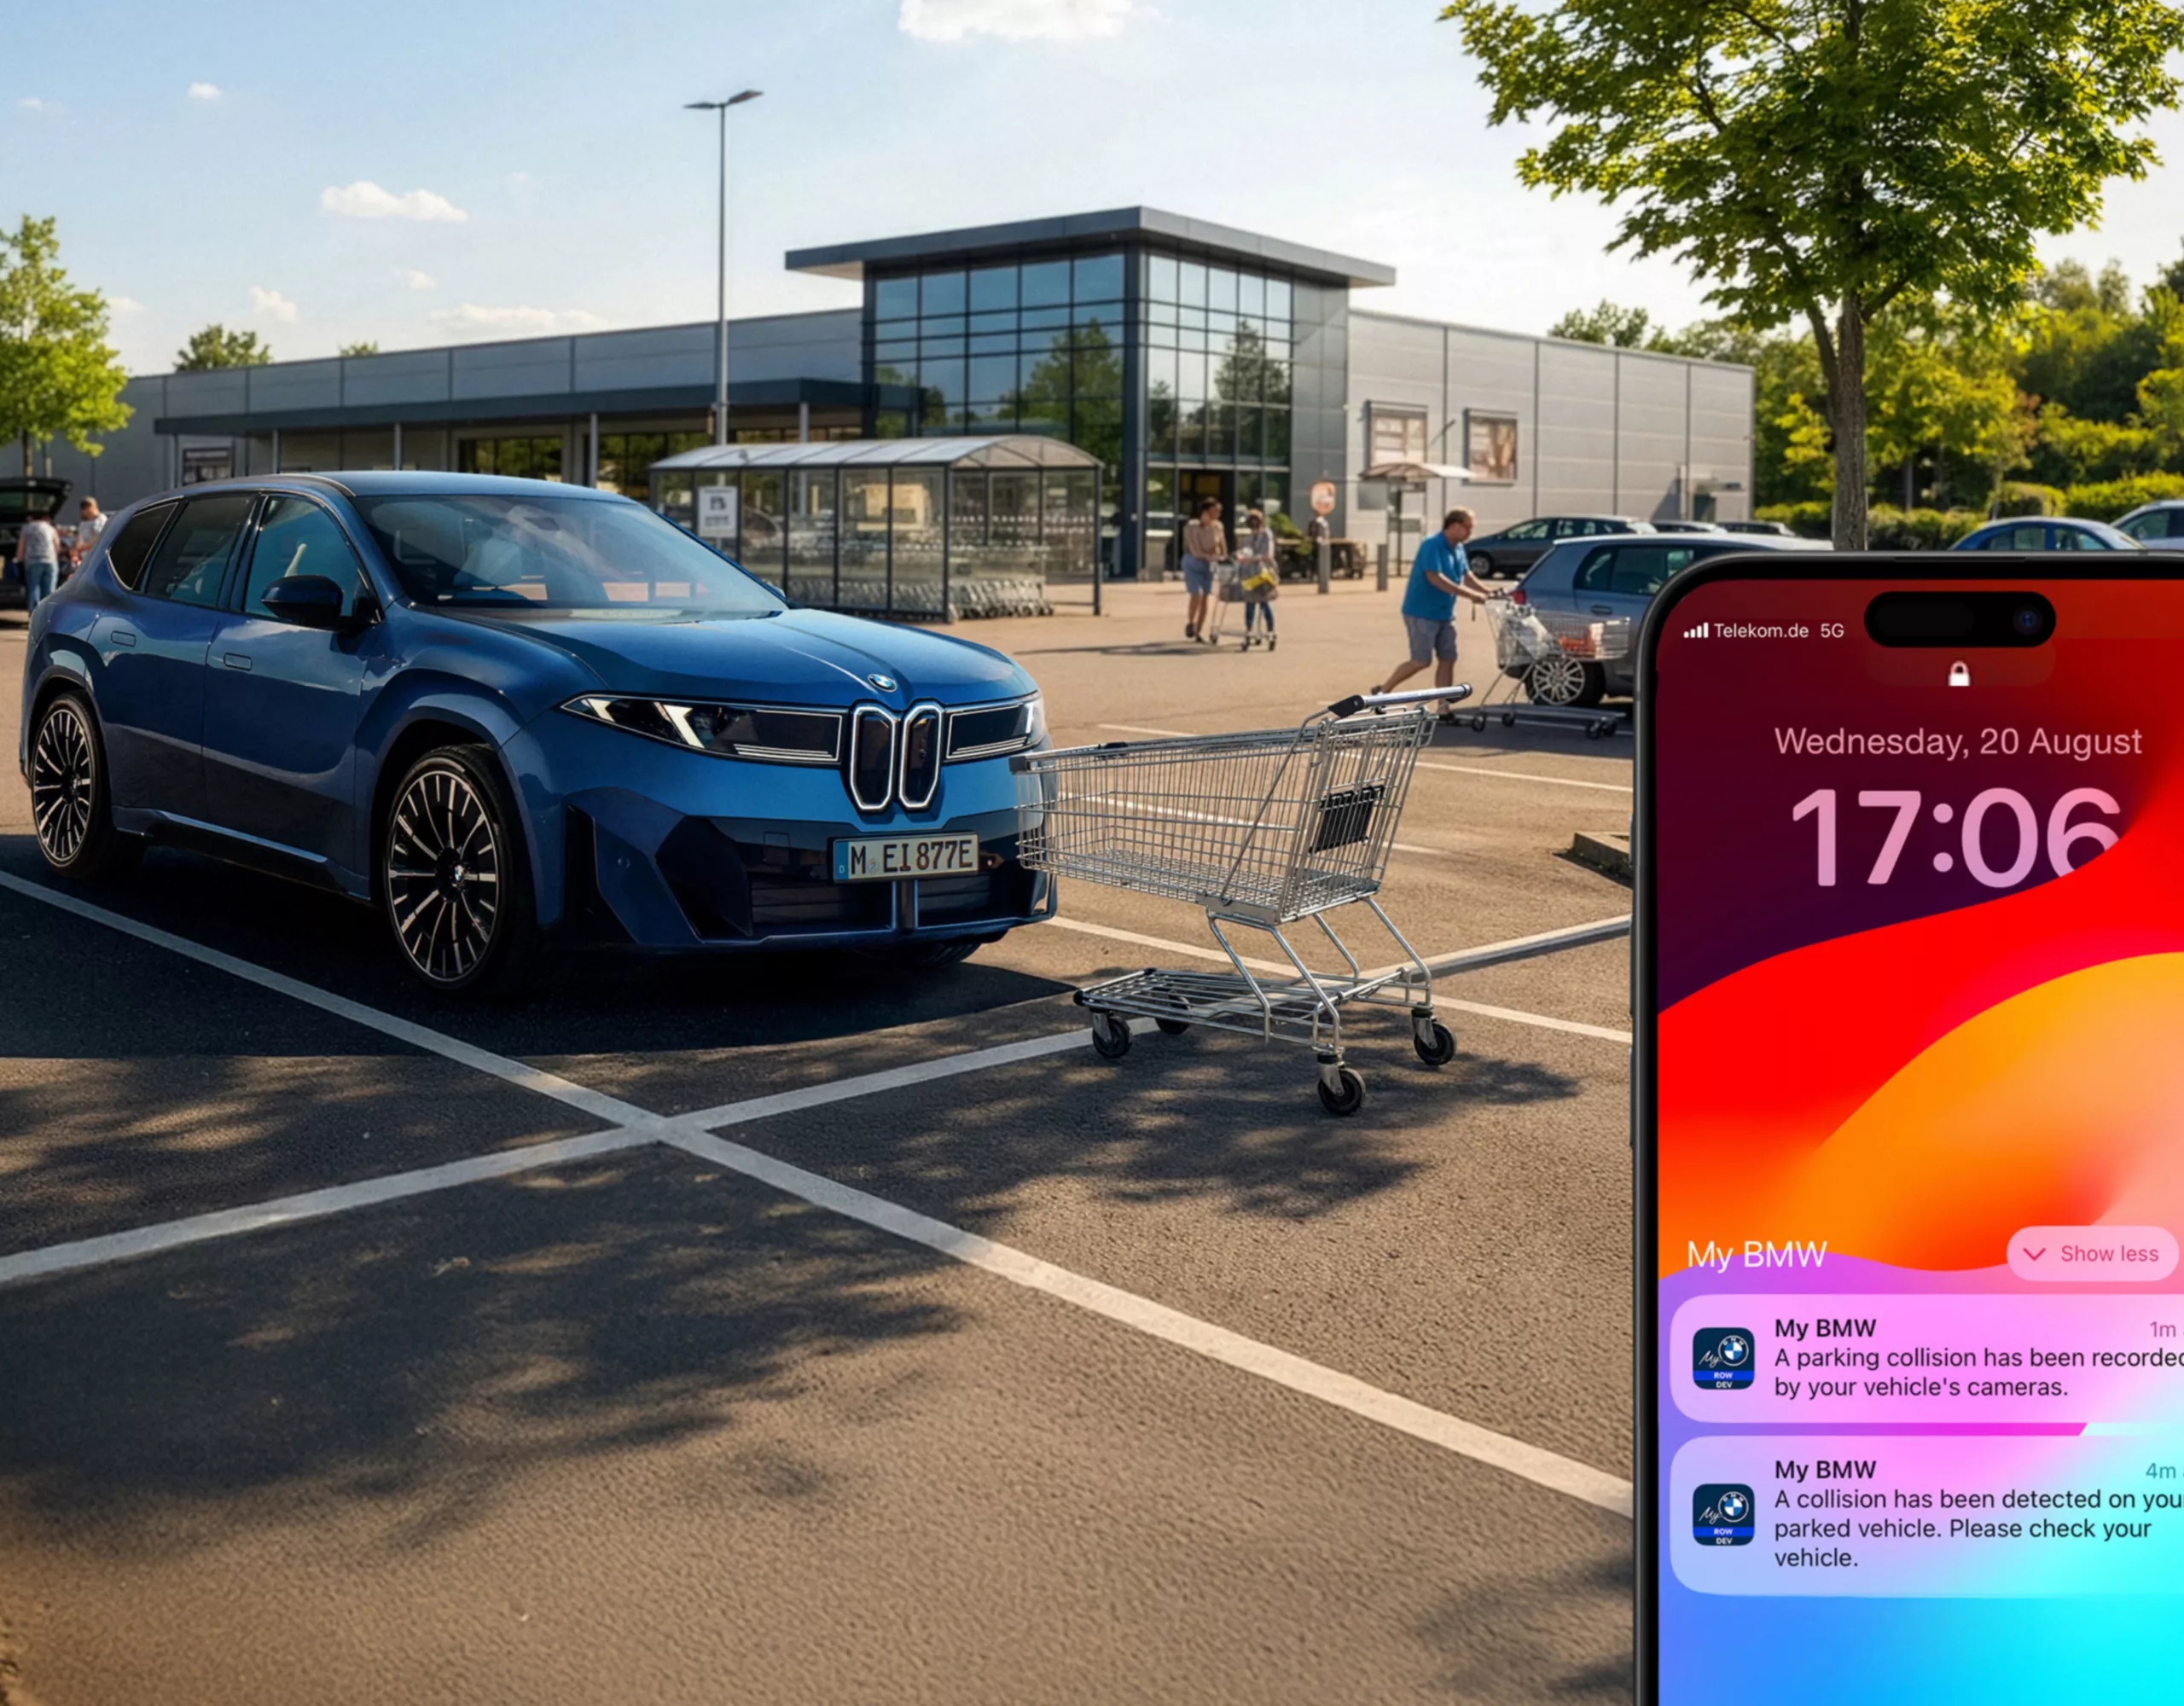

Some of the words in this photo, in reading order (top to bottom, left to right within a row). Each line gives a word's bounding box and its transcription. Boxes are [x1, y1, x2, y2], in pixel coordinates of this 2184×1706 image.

[1713, 623, 1809, 639] Telekom.de
[1821, 623, 1844, 639] 5G
[1774, 727, 1969, 762] Wednesday,
[1980, 727, 2019, 755] 20
[2029, 727, 2143, 762] August
[1792, 786, 2122, 889] 17:06
[851, 845, 866, 874] M
[1687, 1240, 1734, 1274] My
[1743, 1240, 1827, 1268] BMW
[2061, 1245, 2115, 1262] Show
[2122, 1245, 2159, 1262] less
[1774, 1318, 1809, 1343] My
[1815, 1318, 1877, 1338] BMW
[2150, 1320, 2176, 1338] 1m
[1774, 1348, 1791, 1367] A
[1797, 1347, 1879, 1372] parking
[1886, 1347, 1977, 1367] collision
[1984, 1347, 2023, 1367] has
[2030, 1347, 2085, 1367] been
[1774, 1376, 1801, 1401] by
[1808, 1381, 1857, 1401] your
[1863, 1376, 1961, 1396] vehicle's
[1967, 1381, 2068, 1396] cameras.
[1774, 1459, 1809, 1484] My
[1815, 1459, 1877, 1480] BMW
[2146, 1462, 2176, 1479] 4m
[1774, 1489, 1791, 1508] A
[1797, 1488, 1887, 1509] collision
[1894, 1488, 1933, 1509] has
[1940, 1488, 1995, 1509] been
[2001, 1488, 2101, 1509] detected
[2108, 1494, 2135, 1509] on
[2142, 1494, 2184, 1513] you
[1774, 1517, 1850, 1542] parked
[1857, 1517, 1942, 1539] vehicle.
[1950, 1517, 2023, 1539] Please
[2029, 1517, 2096, 1538] check
[2102, 1523, 2152, 1542] your
[1774, 1546, 1858, 1568] vehicle.
